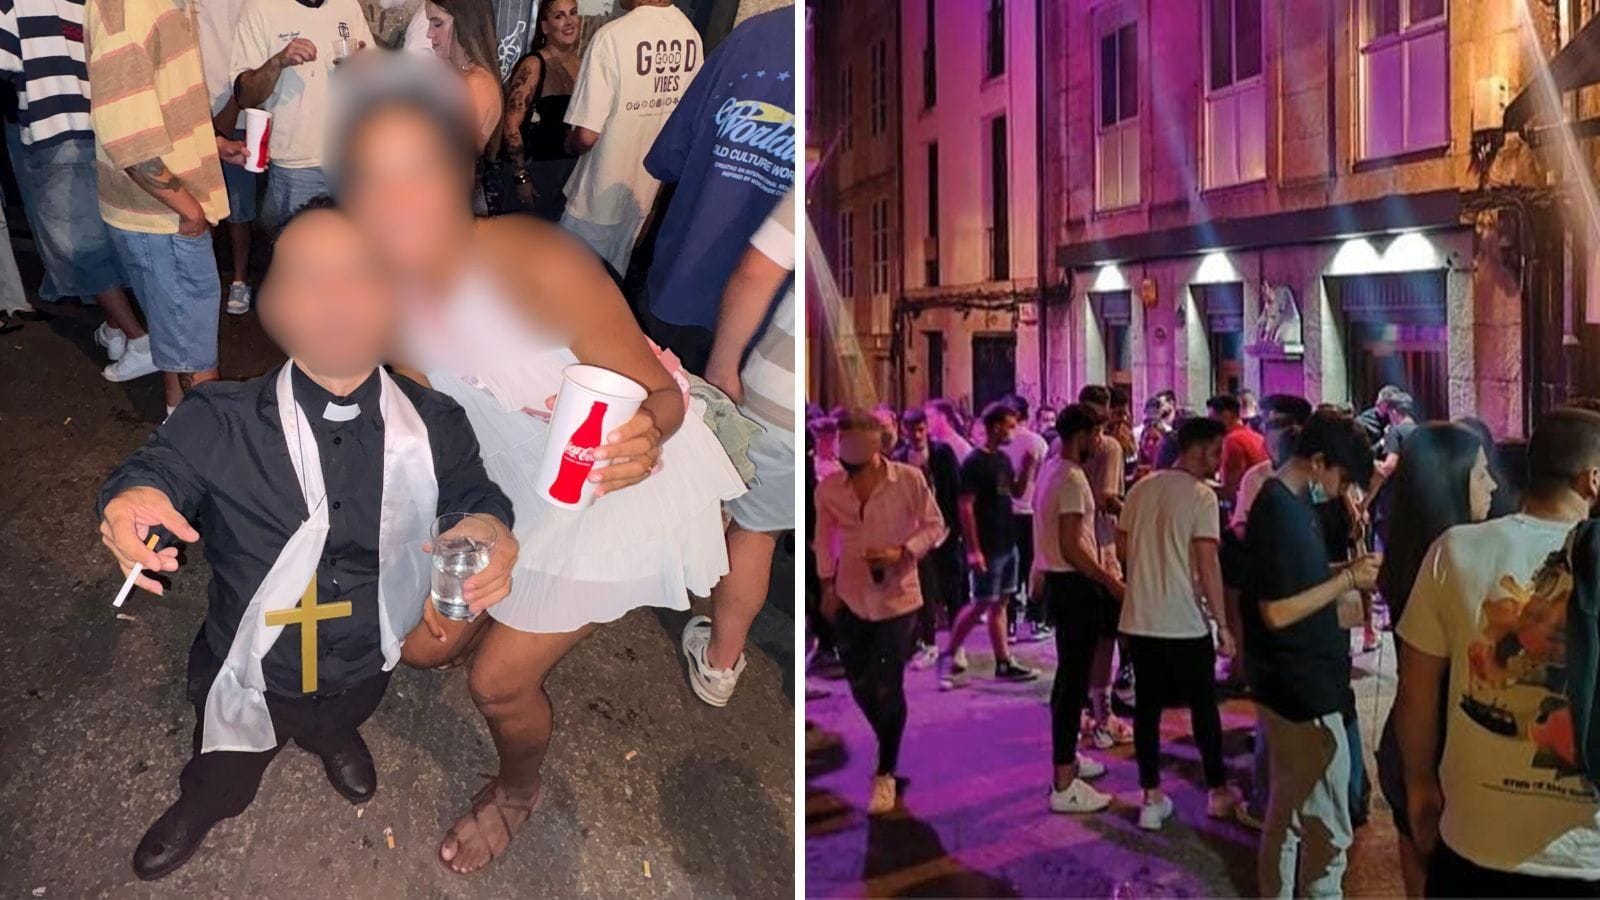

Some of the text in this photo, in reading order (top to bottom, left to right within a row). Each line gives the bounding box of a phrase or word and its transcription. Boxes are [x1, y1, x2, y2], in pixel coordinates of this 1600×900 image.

[636, 39, 697, 76] GOOD
[655, 52, 682, 65] GOOD
[654, 75, 681, 93] VIBES
[730, 148, 773, 172] CULTURE
